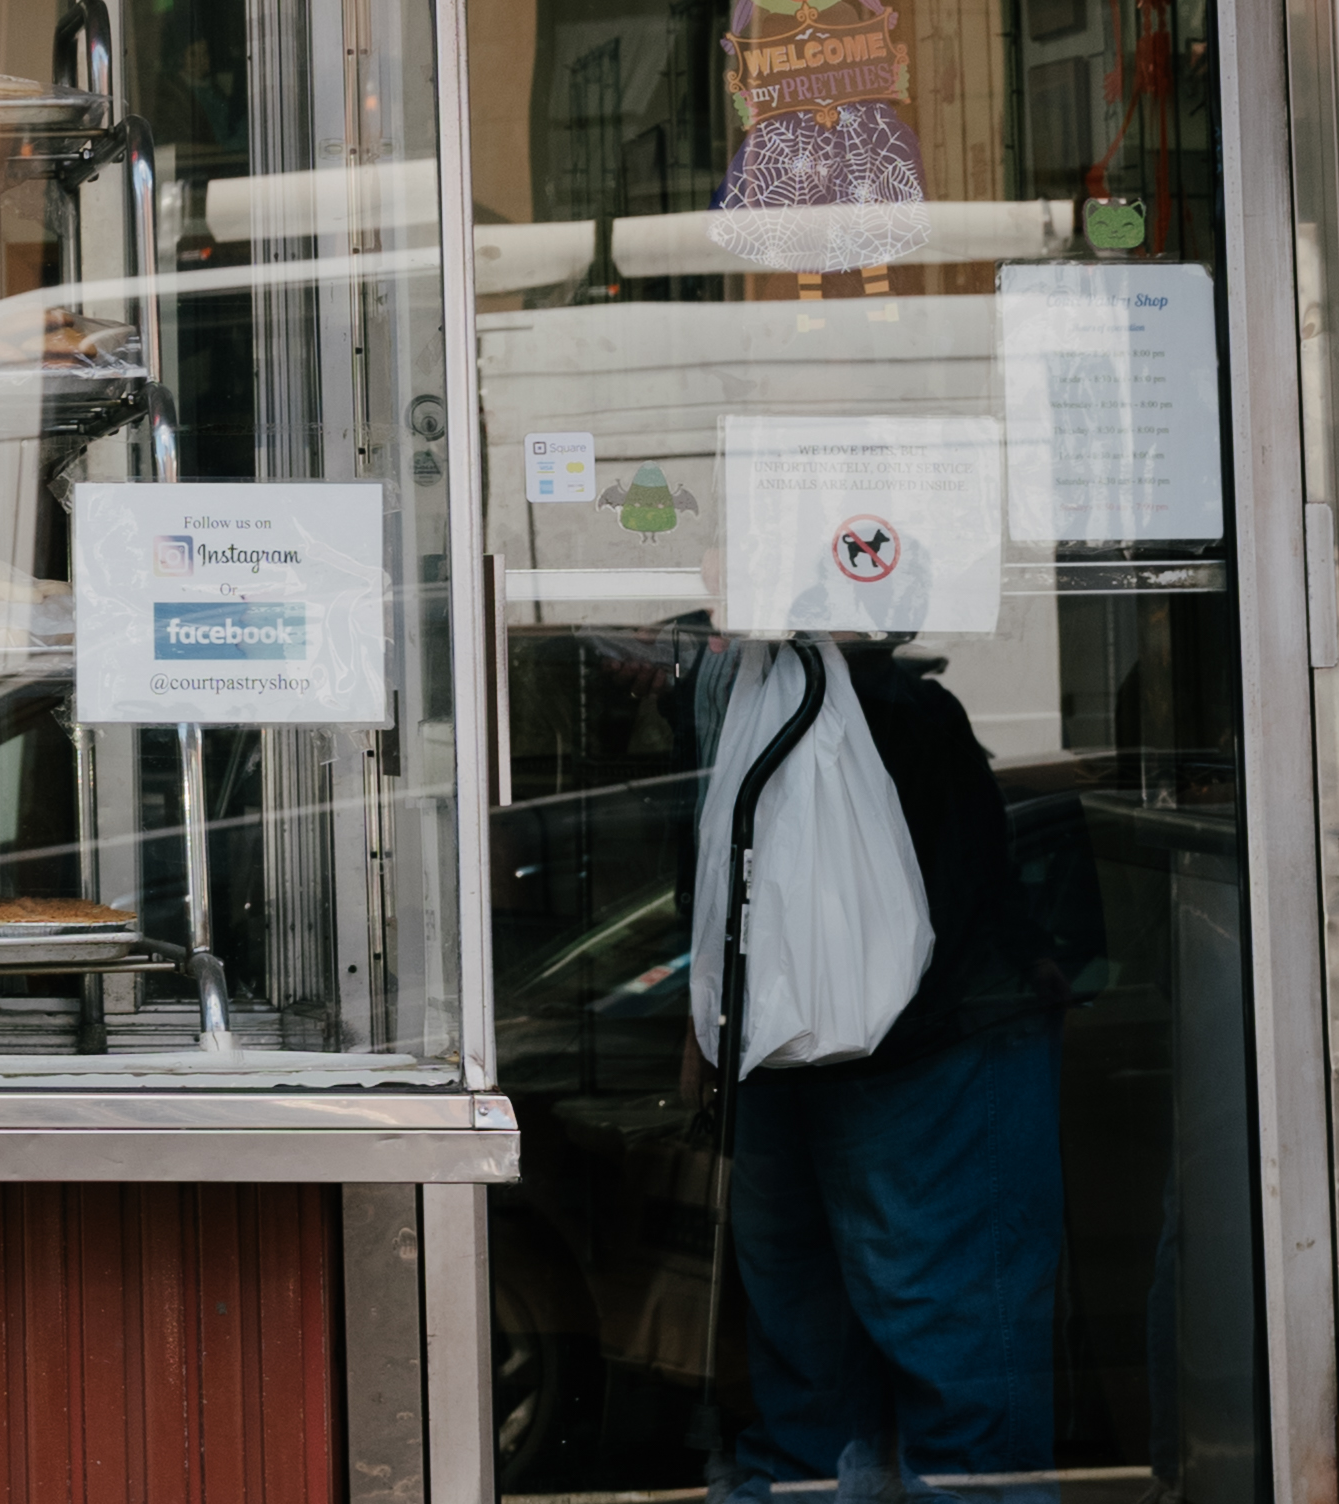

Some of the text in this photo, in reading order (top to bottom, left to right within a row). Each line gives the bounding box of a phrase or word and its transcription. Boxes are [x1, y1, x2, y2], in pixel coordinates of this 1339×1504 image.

[744, 31, 888, 77] WELCOME
[751, 63, 892, 108] my PRETTIES
[1134, 292, 1169, 311] Shop
[1132, 348, 1151, 358] 8:00
[1152, 350, 1166, 360] pm
[1153, 376, 1167, 386] pm
[1140, 400, 1159, 410] 8:00
[1160, 402, 1173, 412] pm
[1136, 425, 1156, 435] 8:00
[1156, 428, 1170, 438] pm
[549, 442, 587, 455] Square
[798, 445, 820, 455] WE
[822, 445, 858, 455] LOVE
[900, 445, 928, 456] BUT
[876, 462, 913, 474] ONLY
[916, 463, 973, 474] SERVICE
[756, 479, 970, 492] ANIMALS ARE ALLOWED INSIDE.
[1157, 479, 1171, 489] pm
[183, 515, 272, 530] Follow us on
[196, 543, 302, 574] Instagram
[219, 582, 238, 596] Or
[166, 618, 292, 645] facebook
[149, 672, 310, 695] @courtpastryshop
